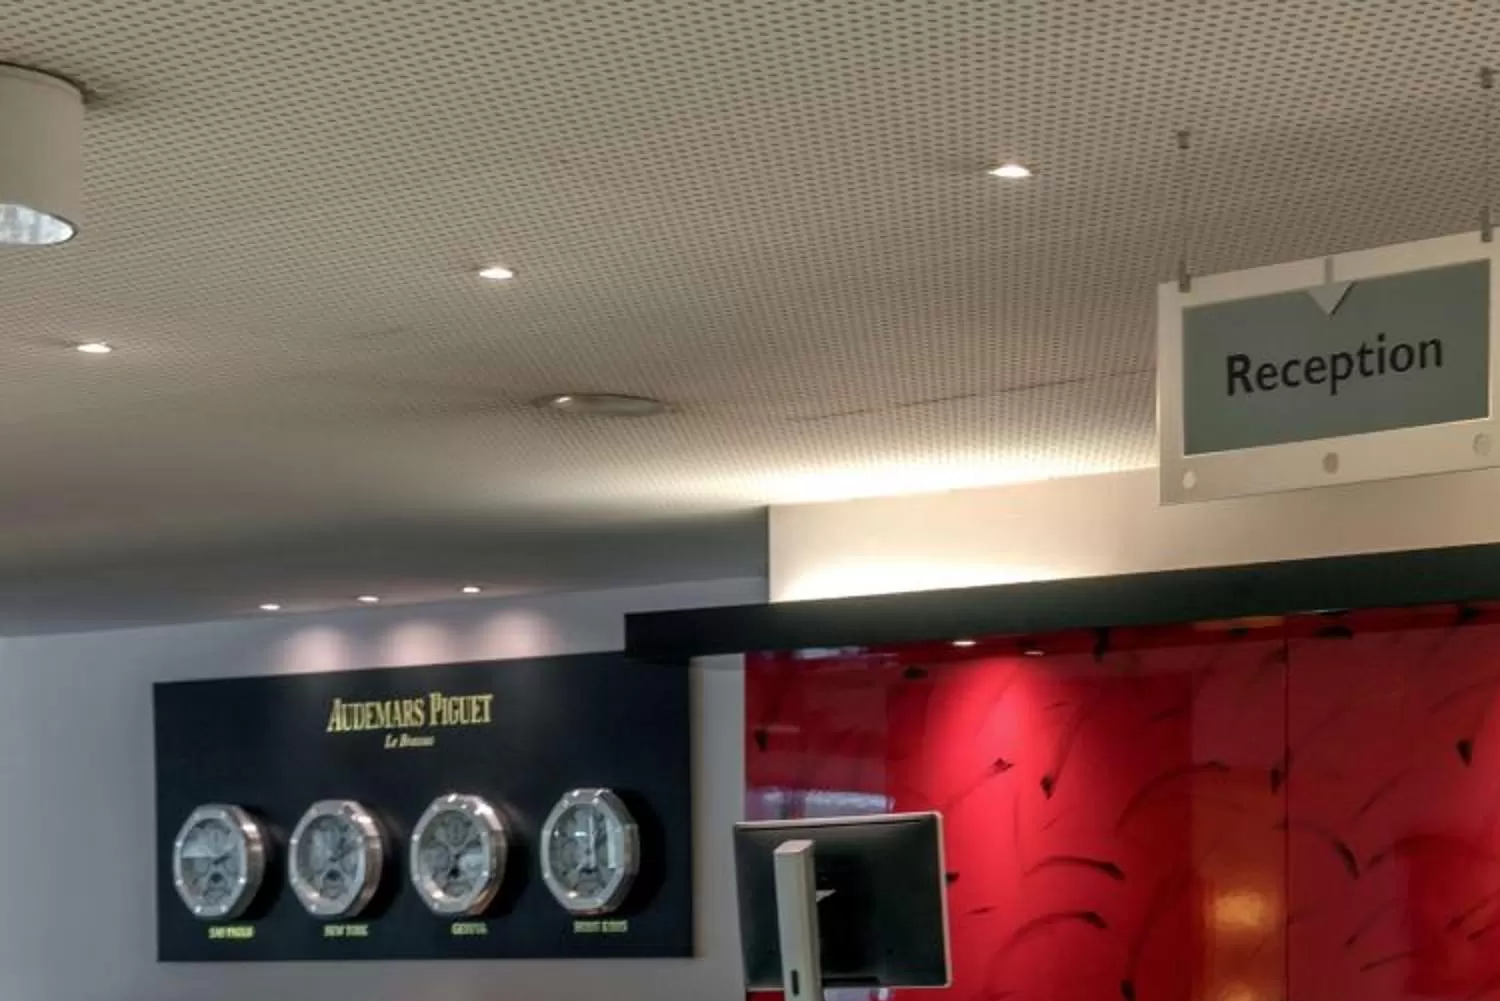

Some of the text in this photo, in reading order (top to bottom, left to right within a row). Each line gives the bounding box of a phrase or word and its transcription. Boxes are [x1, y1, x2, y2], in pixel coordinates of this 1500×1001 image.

[1226, 332, 1444, 397] Reception
[326, 691, 494, 733] AUDEMARS PIGUET
